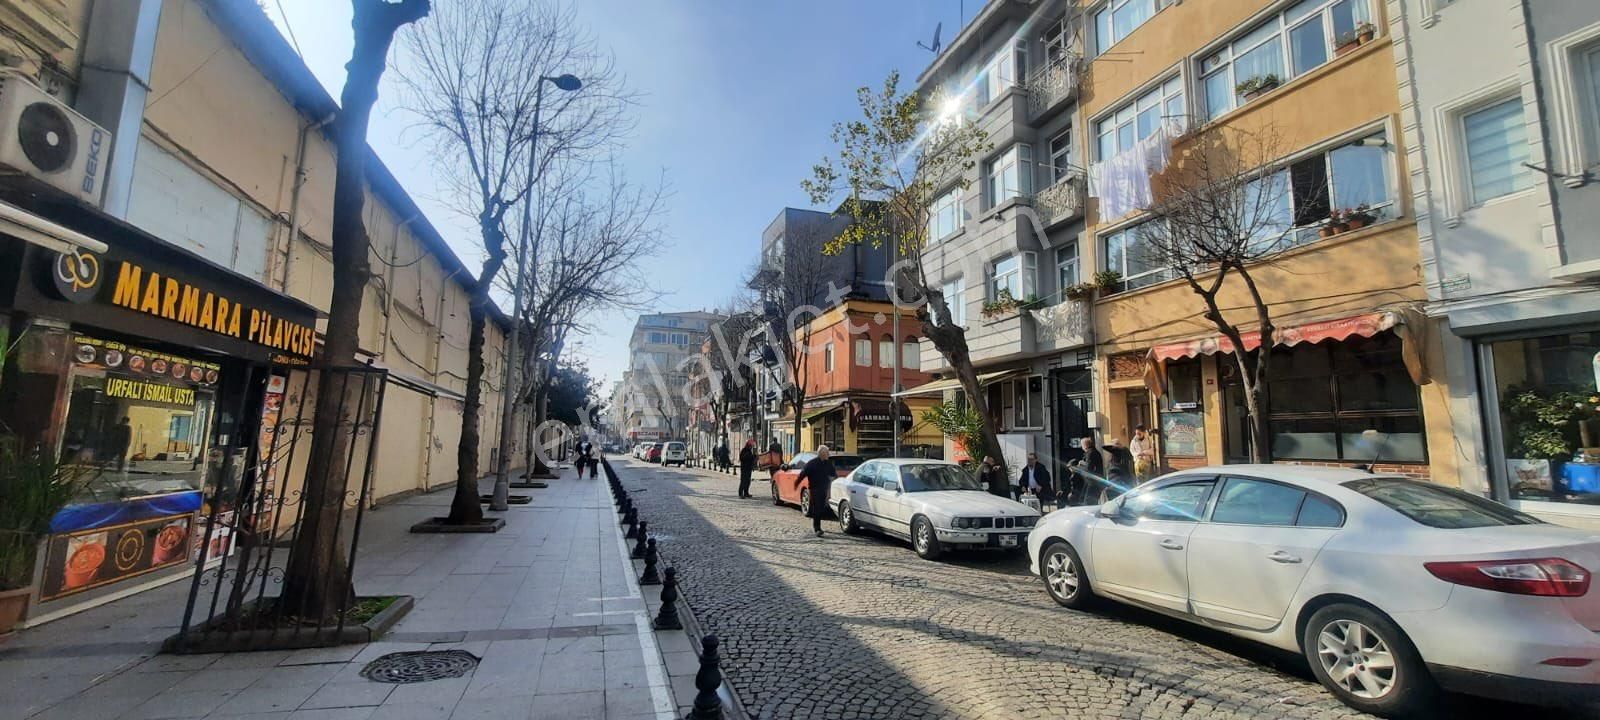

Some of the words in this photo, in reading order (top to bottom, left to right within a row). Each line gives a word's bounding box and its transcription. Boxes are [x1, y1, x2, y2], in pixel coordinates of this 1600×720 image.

[81, 127, 102, 194] BEKO
[112, 261, 241, 338] MARMARA
[107, 378, 142, 399] URFALI
[174, 388, 195, 406] USTA
